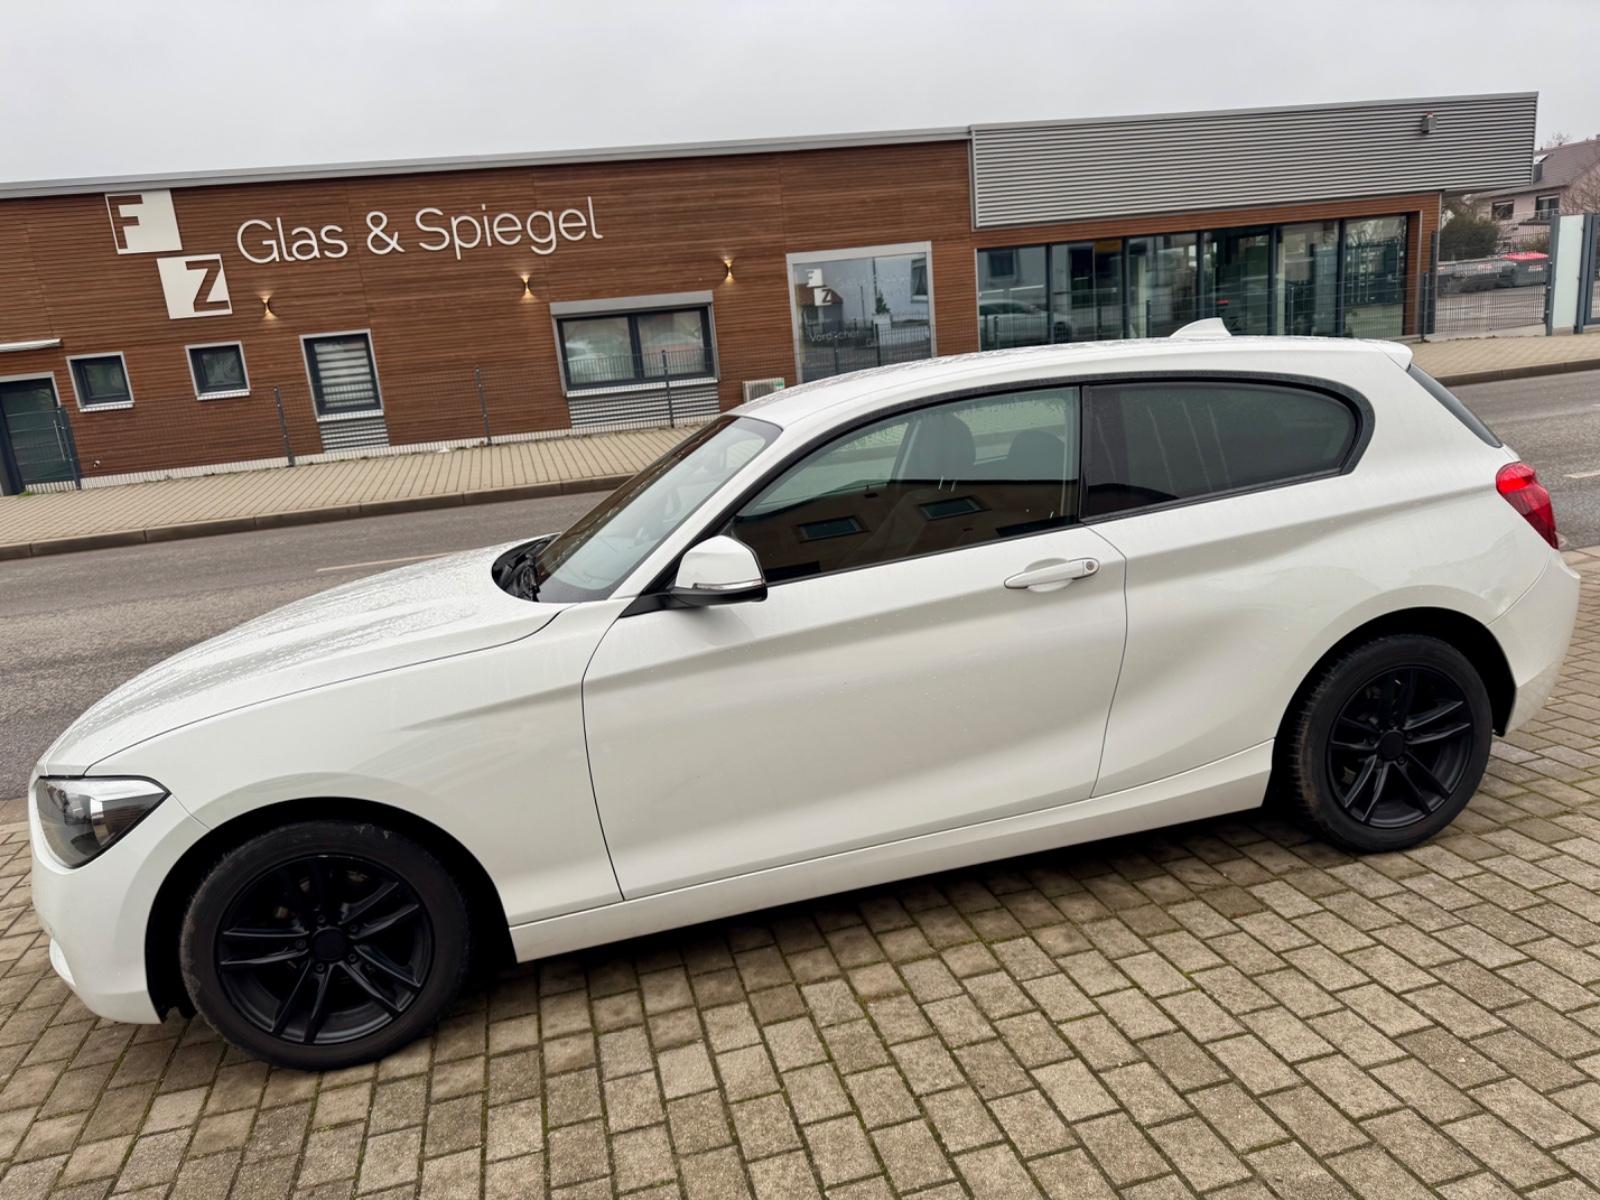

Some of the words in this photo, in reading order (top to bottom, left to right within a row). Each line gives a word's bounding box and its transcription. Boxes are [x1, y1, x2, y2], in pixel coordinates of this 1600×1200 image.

[236, 217, 348, 264] Glas
[366, 211, 405, 255] &
[415, 196, 603, 260] Spiegel
[809, 329, 860, 342] Vordcher
